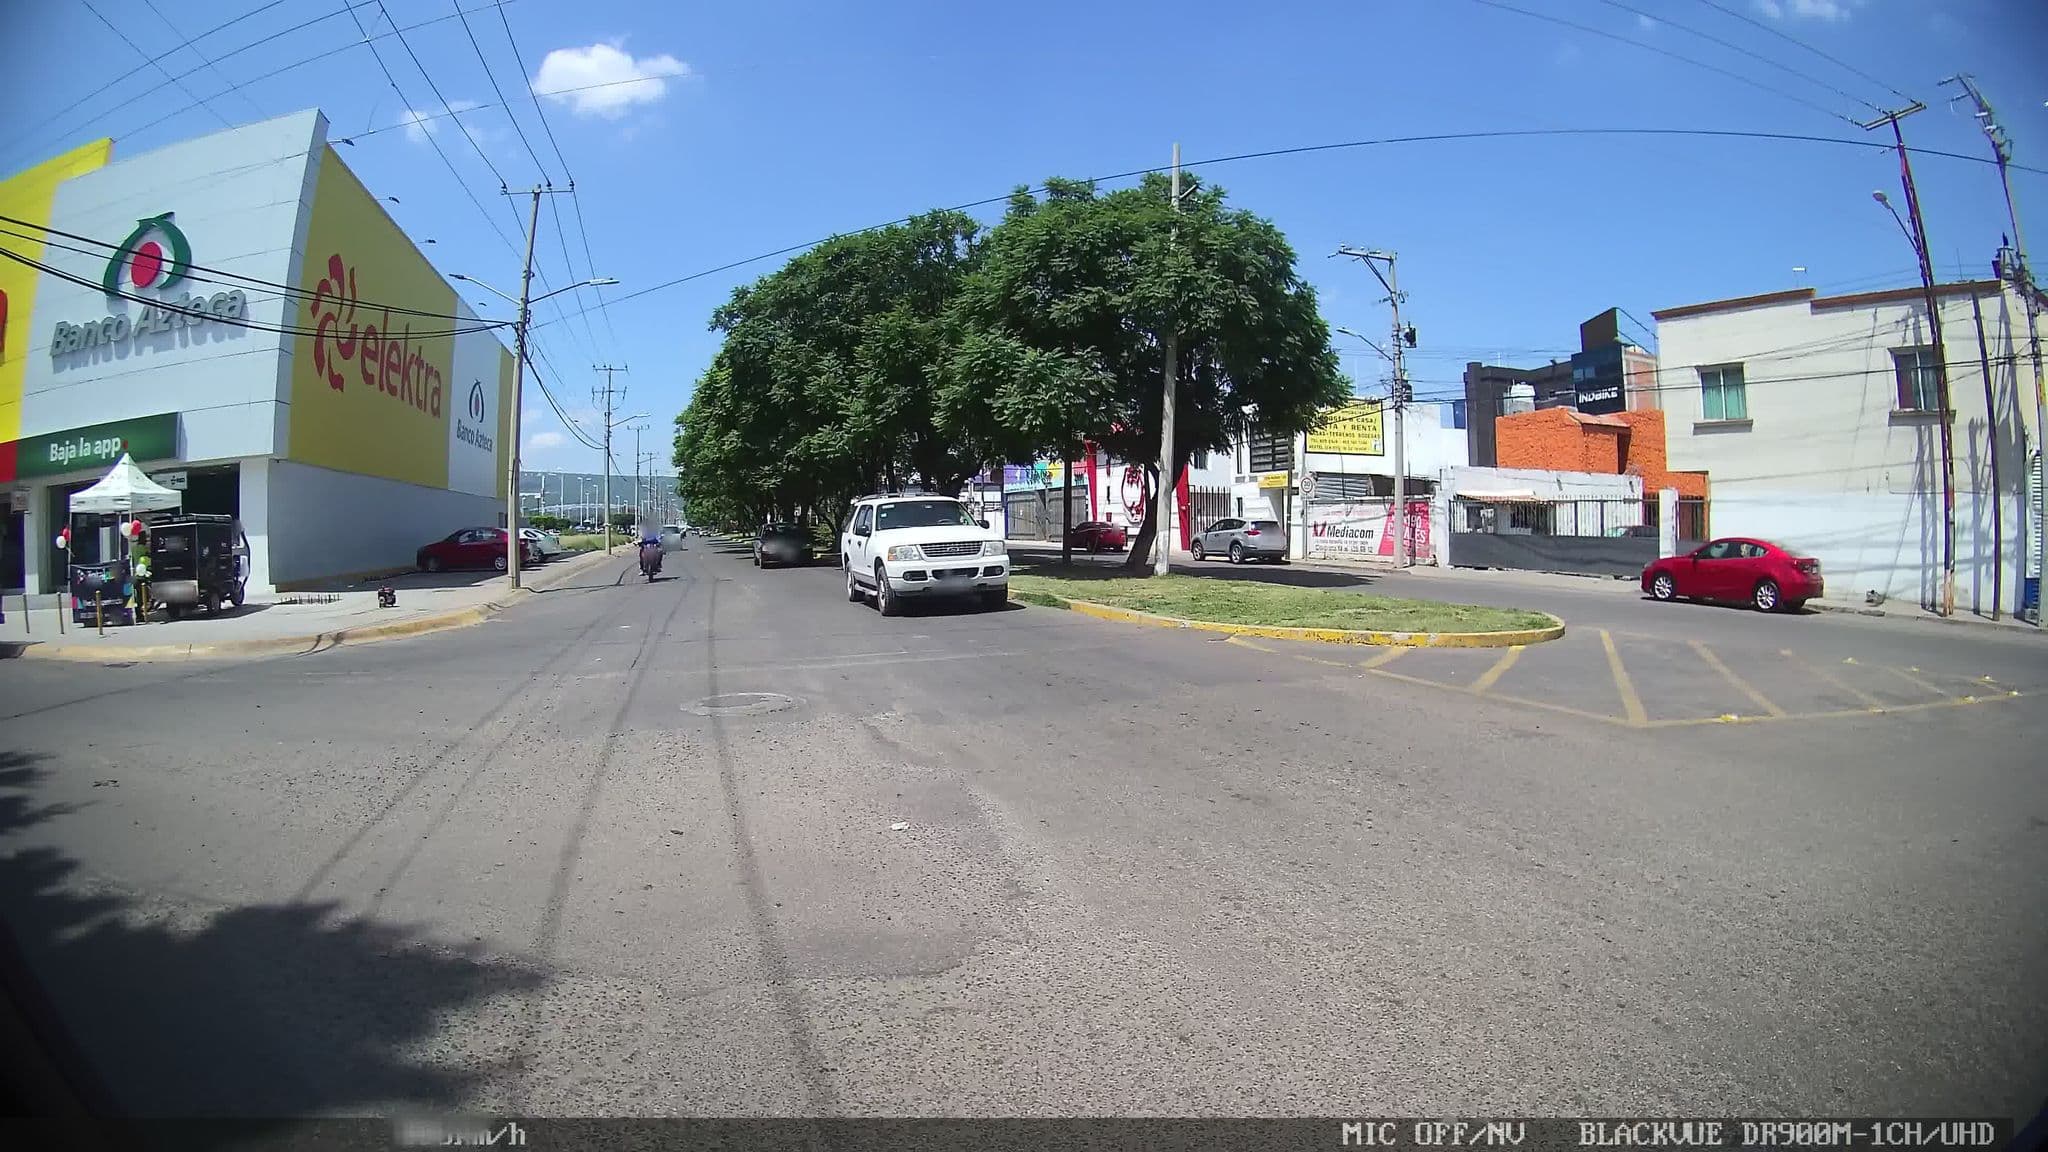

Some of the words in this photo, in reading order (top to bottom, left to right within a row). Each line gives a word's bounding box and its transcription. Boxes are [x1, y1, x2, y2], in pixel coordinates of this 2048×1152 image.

[50, 314, 132, 357] Banco
[133, 289, 247, 337] Azteca
[360, 308, 442, 419] elektra
[456, 418, 475, 445] Banco
[475, 428, 492, 452] Azteca
[1351, 424, 1377, 432] RENTA
[49, 440, 76, 465] Baja
[79, 437, 91, 457] la
[93, 437, 121, 459] app
[1326, 525, 1374, 539] Mediacom
